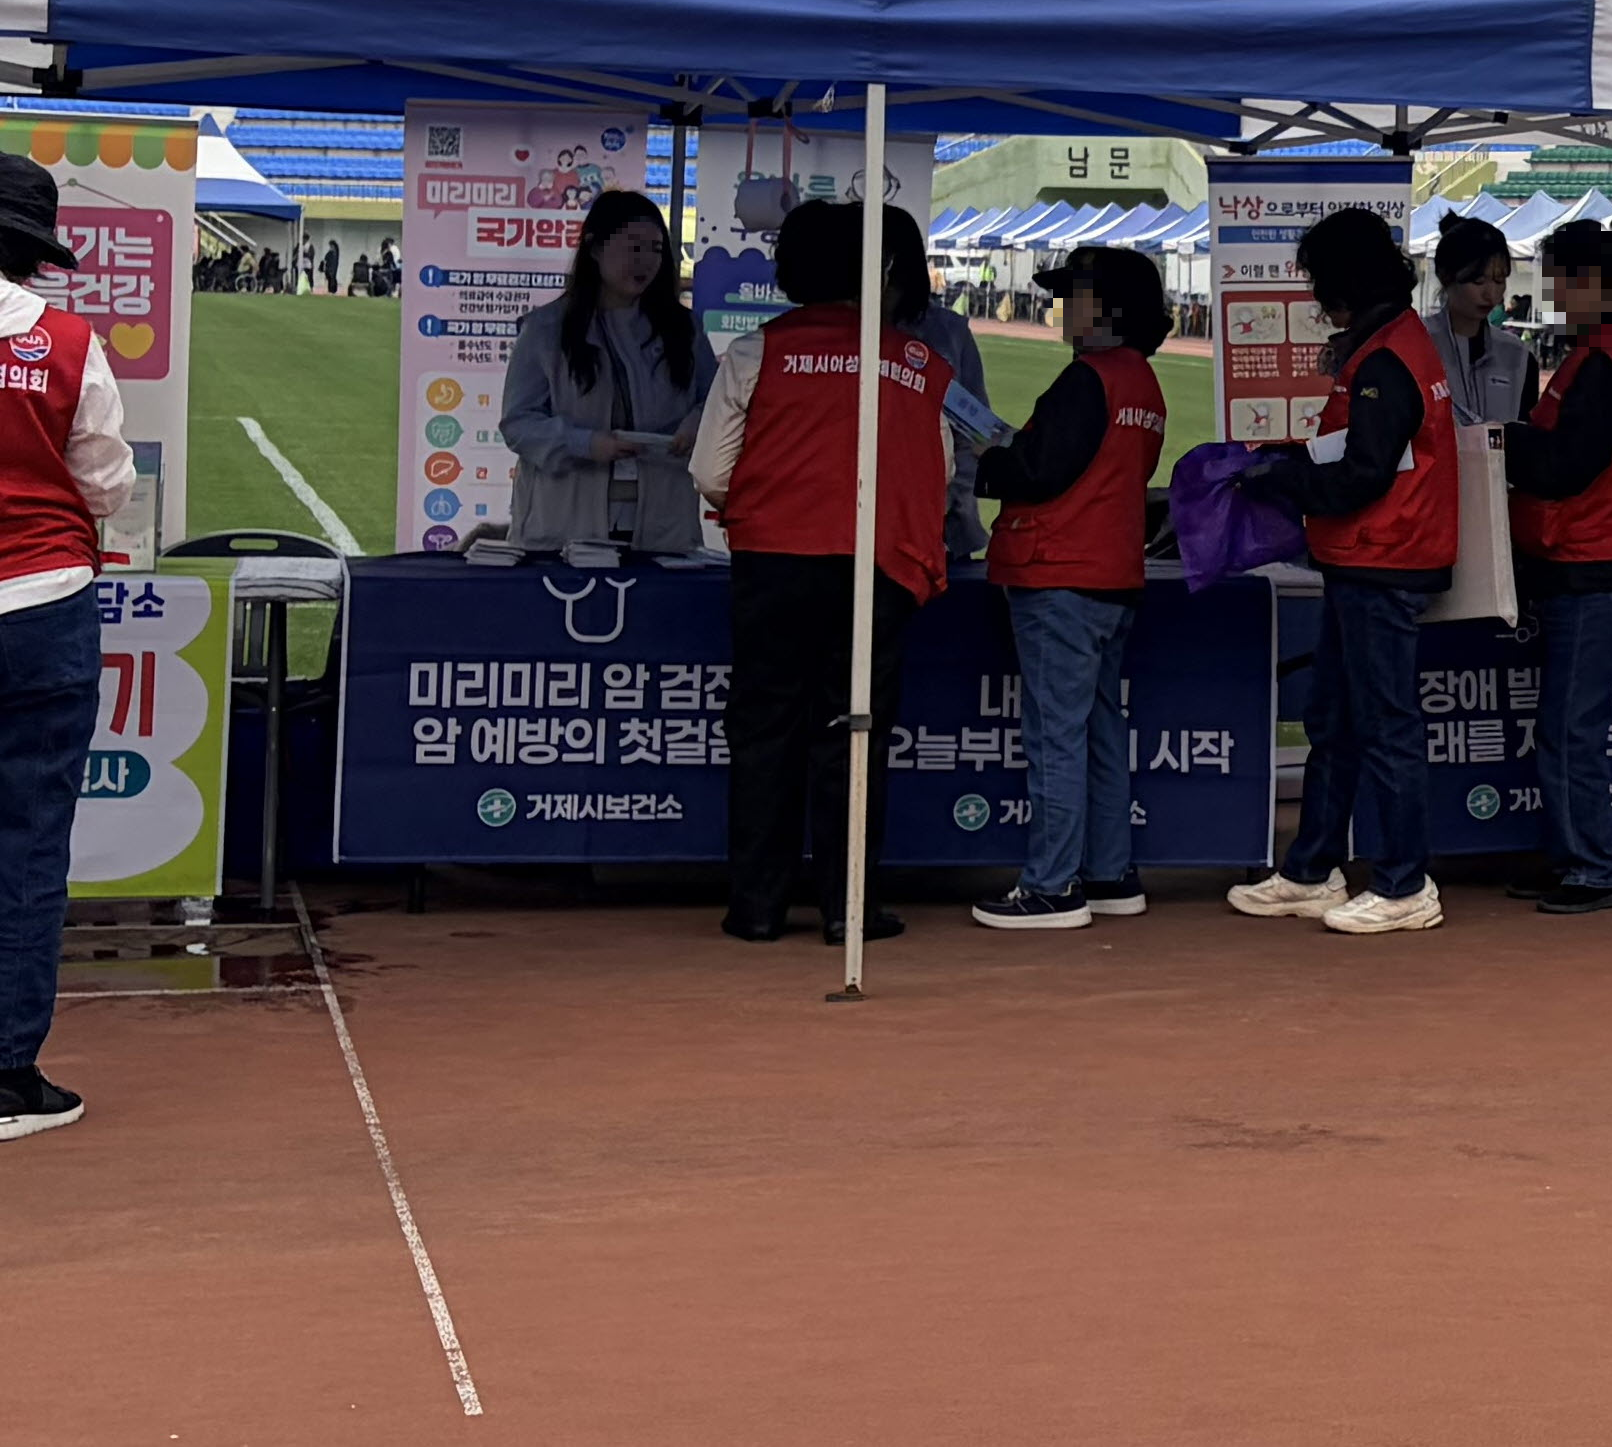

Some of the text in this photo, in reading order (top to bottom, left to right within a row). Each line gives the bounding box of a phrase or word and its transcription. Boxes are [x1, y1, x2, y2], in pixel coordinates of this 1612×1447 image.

[425, 180, 517, 207] 미리미리
[409, 661, 592, 709] 미리미리
[602, 663, 650, 710] 암
[1419, 668, 1498, 714] 장애
[413, 717, 462, 765] 암
[470, 717, 607, 765] 예방의
[1150, 730, 1235, 774] 시작
[81, 757, 130, 794] 사
[526, 793, 684, 821] 거제시보건소
